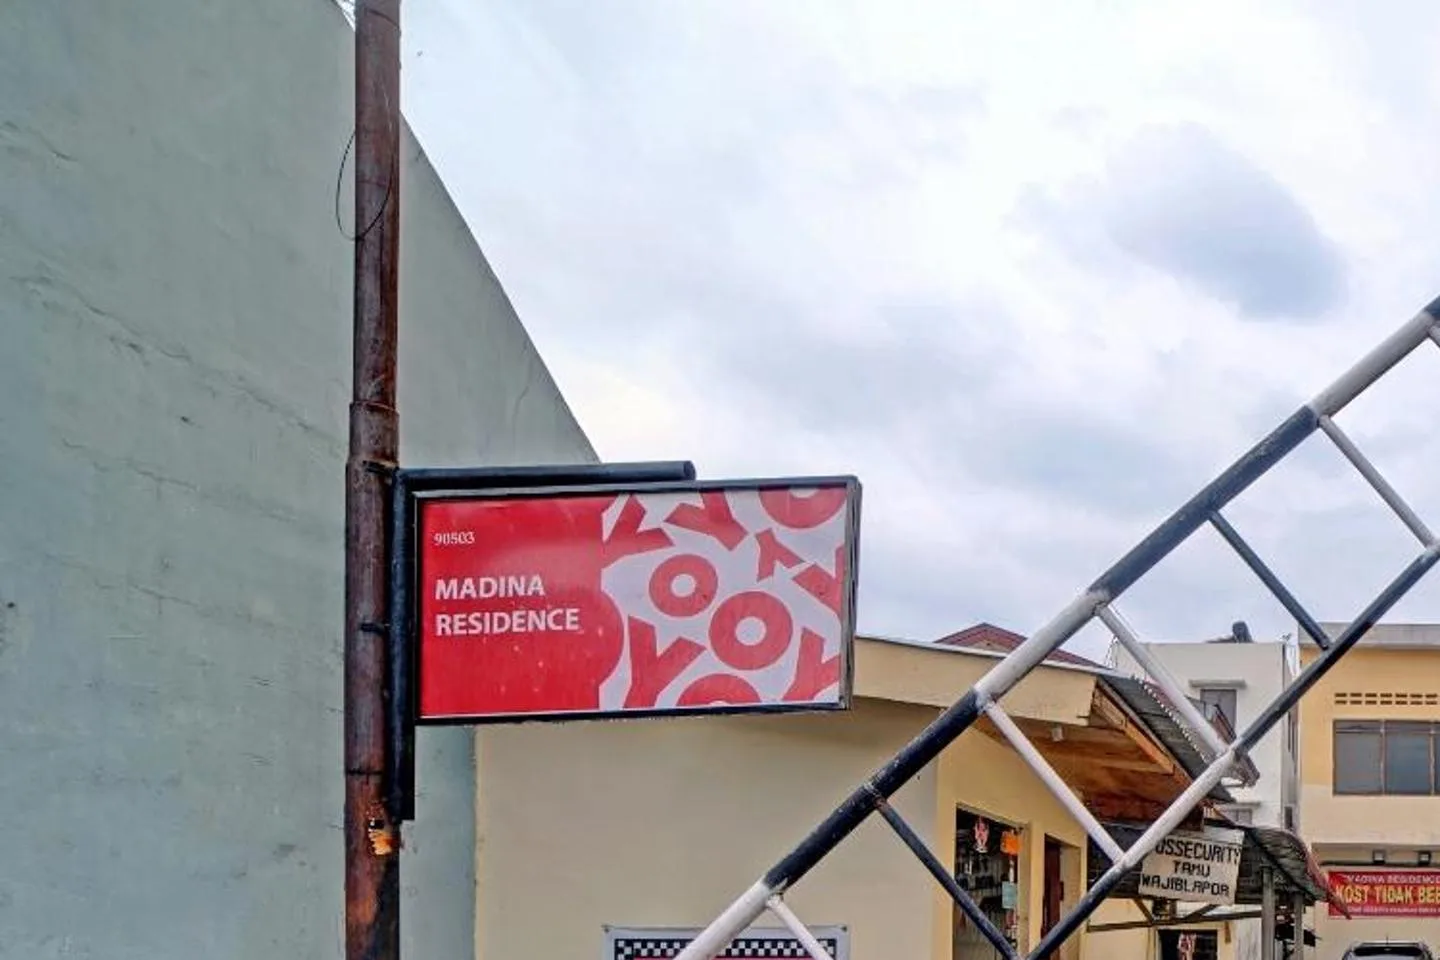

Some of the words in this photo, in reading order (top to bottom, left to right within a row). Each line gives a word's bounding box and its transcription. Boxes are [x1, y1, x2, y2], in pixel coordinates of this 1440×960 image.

[435, 574, 545, 600] MADINA
[435, 608, 580, 636] RESIDENCE
[1155, 837, 1241, 864] OSSECURITY
[1173, 860, 1210, 878] TAMU
[1141, 875, 1229, 896] WAJIBLAPOR
[1335, 884, 1369, 903] KOST
[1375, 885, 1413, 904] TIDAK
